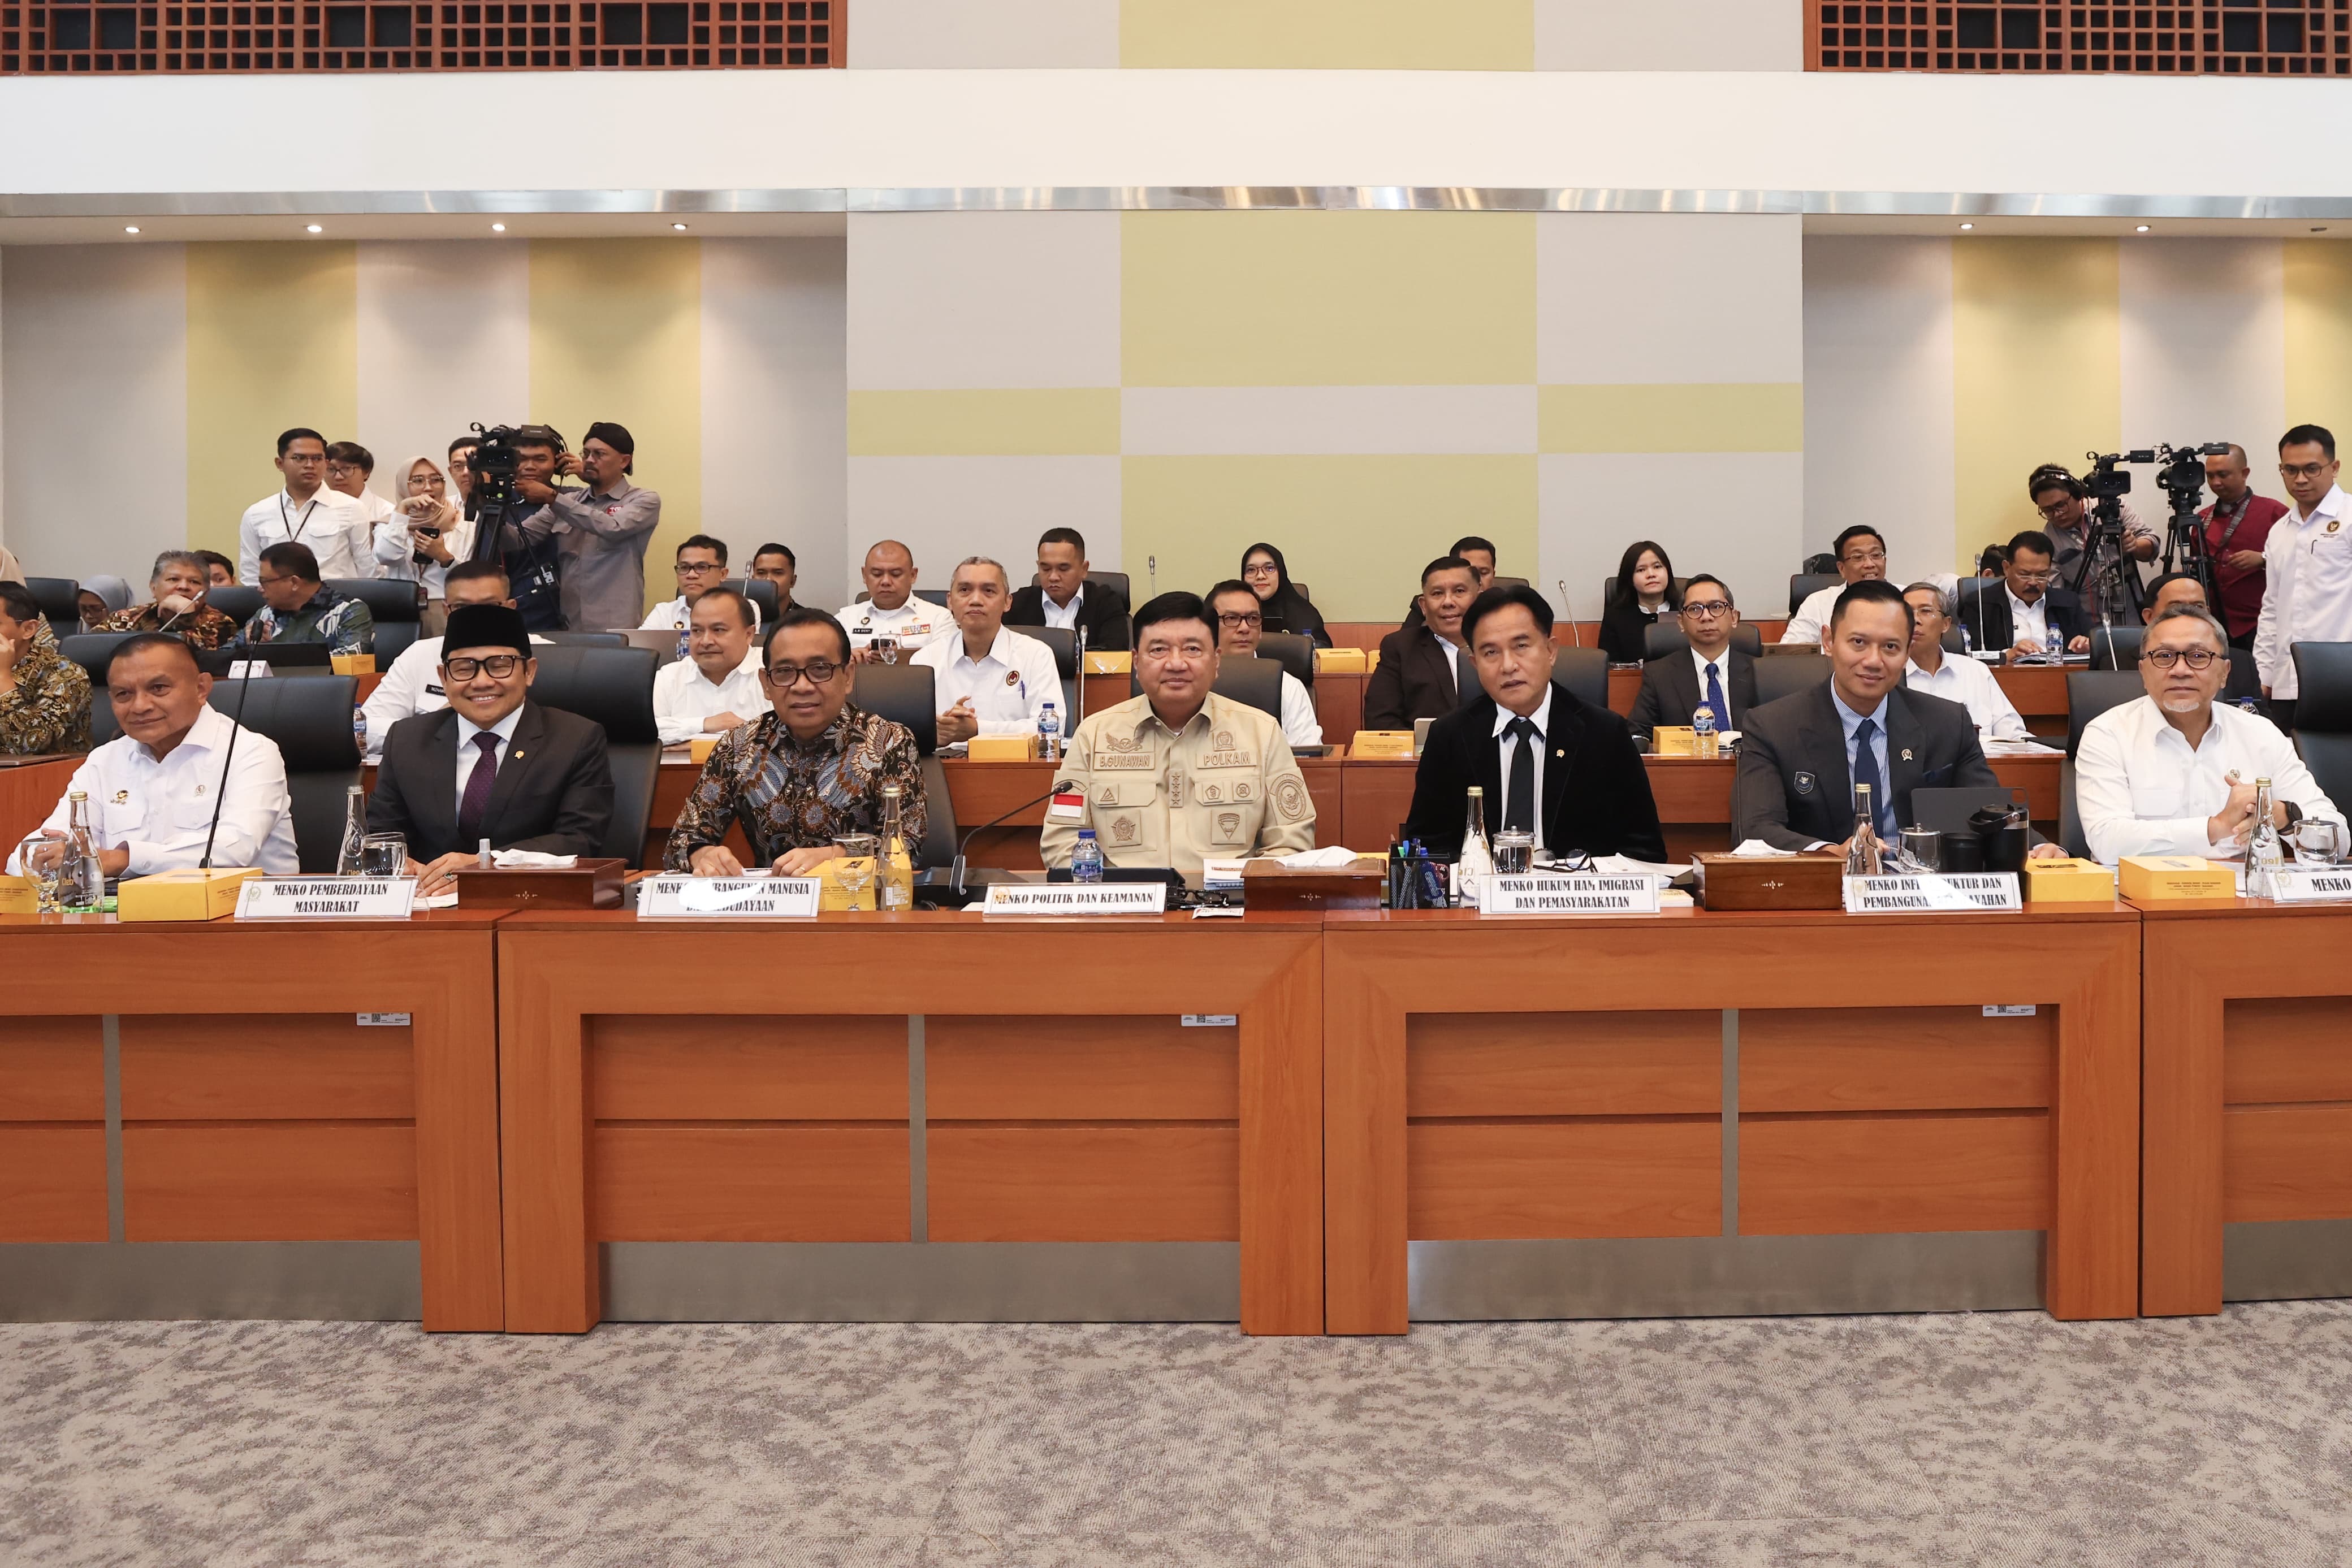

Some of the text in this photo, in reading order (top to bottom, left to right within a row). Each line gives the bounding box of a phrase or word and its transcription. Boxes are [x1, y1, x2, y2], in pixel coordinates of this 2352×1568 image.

[1204, 751, 1250, 766] POLKAM
[273, 883, 388, 896] MENKO PEMBERDAYAAN
[656, 882, 688, 894] MENK
[768, 882, 809, 894] MANUSIA
[1500, 879, 1644, 892] MENKO HUKUM HAM IMIGRASI
[1865, 879, 1898, 891] MENKO
[1981, 877, 2002, 889] DAN
[2311, 877, 2351, 891] MENKO
[994, 893, 1153, 904] MENKO POLITIK DAN KEAMANAN
[1515, 896, 1630, 908] DAN PEMASYARAKATAN
[1864, 895, 1931, 908] PEMBANGUNA
[293, 900, 360, 912] MASYARAKAT
